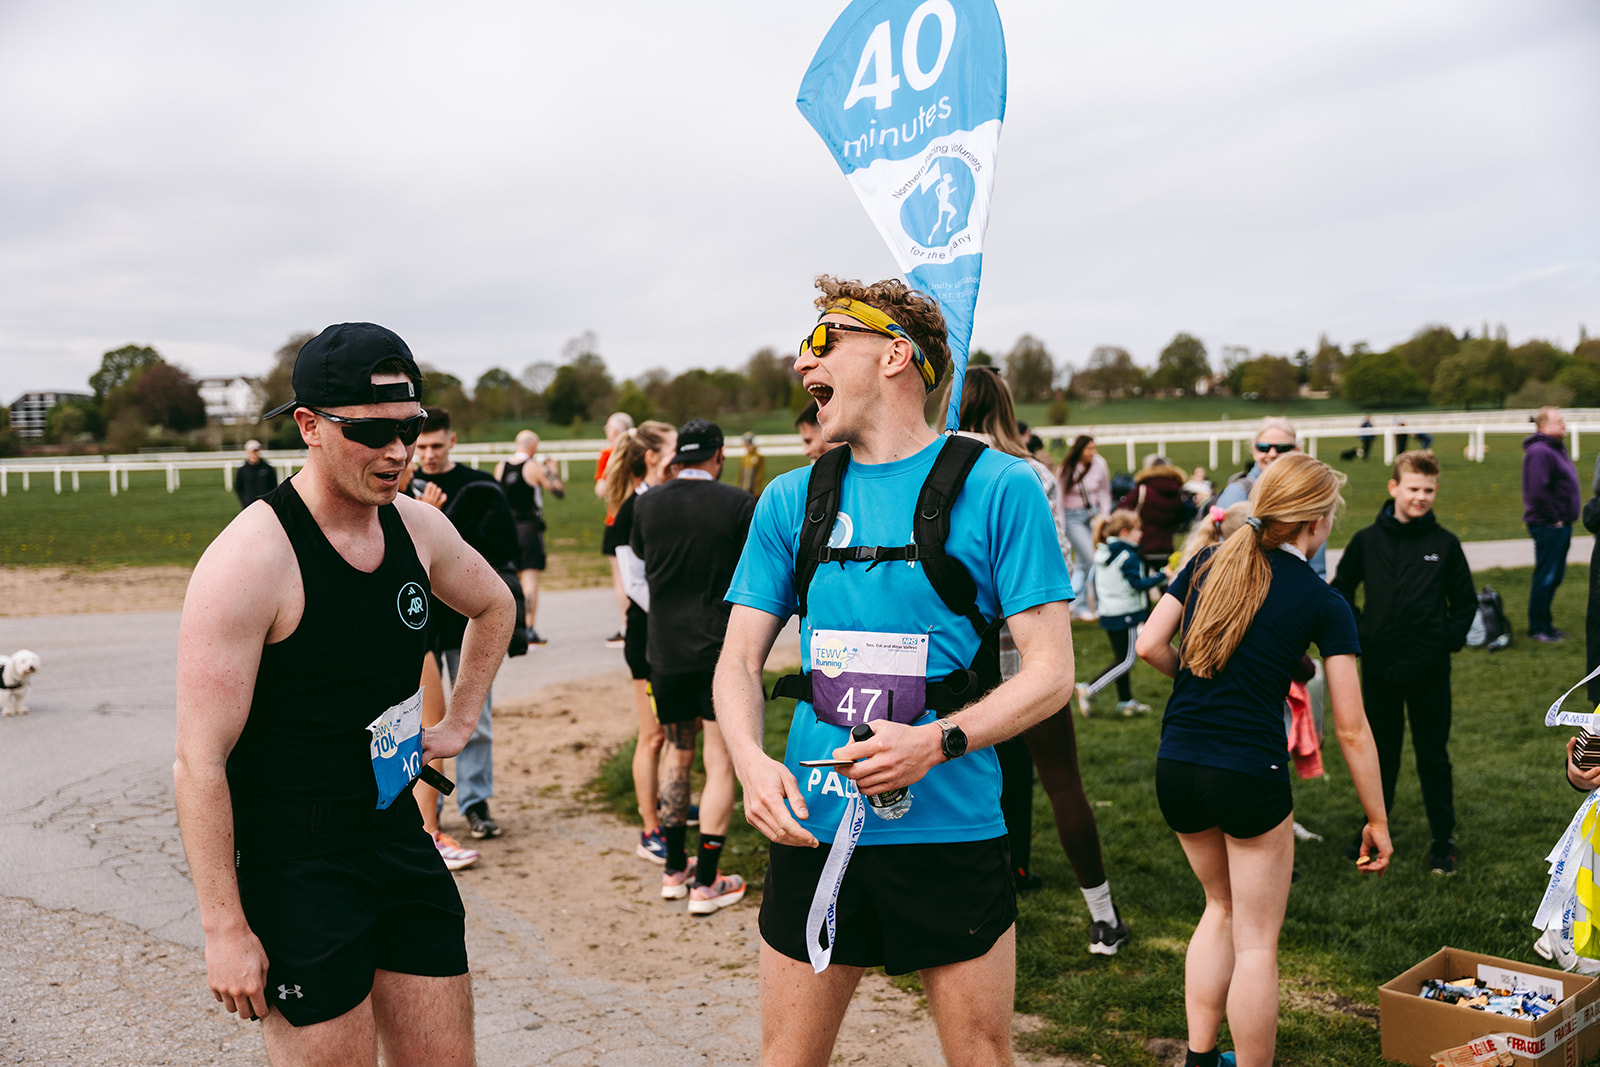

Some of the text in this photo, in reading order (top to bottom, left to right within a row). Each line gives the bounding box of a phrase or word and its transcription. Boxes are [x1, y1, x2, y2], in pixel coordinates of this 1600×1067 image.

[844, 0, 957, 110] 40
[844, 95, 952, 158] minutes
[892, 165, 926, 199] Northern
[910, 246, 925, 257] for
[927, 251, 946, 260] the
[816, 648, 841, 658] TEWV
[816, 659, 842, 669] Running
[837, 687, 882, 722] 47
[1562, 713, 1590, 724] TEWV
[374, 733, 397, 756] 10k
[827, 902, 835, 926] 10k
[852, 816, 863, 839] 10k
[1554, 860, 1566, 876] 10k
